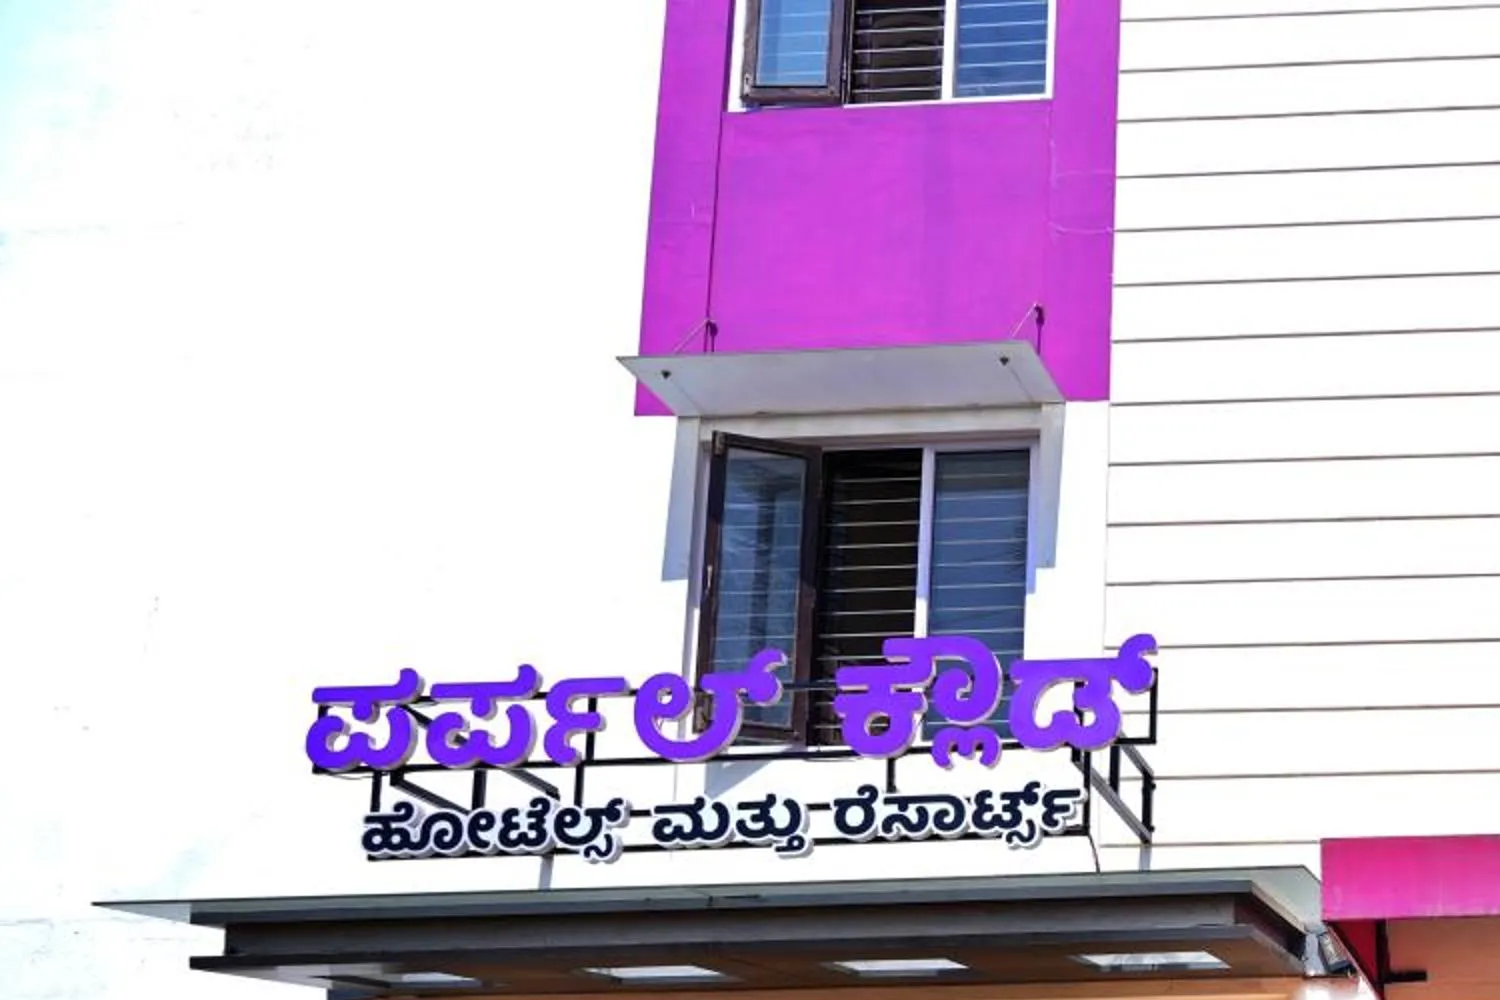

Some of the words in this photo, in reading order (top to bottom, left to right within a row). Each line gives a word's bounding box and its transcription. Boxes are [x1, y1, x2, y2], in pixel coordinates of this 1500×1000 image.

[305, 646, 789, 770] ಪರ್ಪಲ್
[834, 633, 1158, 769] ಕ್ಲೌಡ್
[361, 796, 628, 861] ಹೋಟೆಲ್ಸ್
[651, 792, 807, 854] ಮತ್ತು
[833, 781, 1082, 845] ರೆಸಾರ್ಟ್ಸ್
